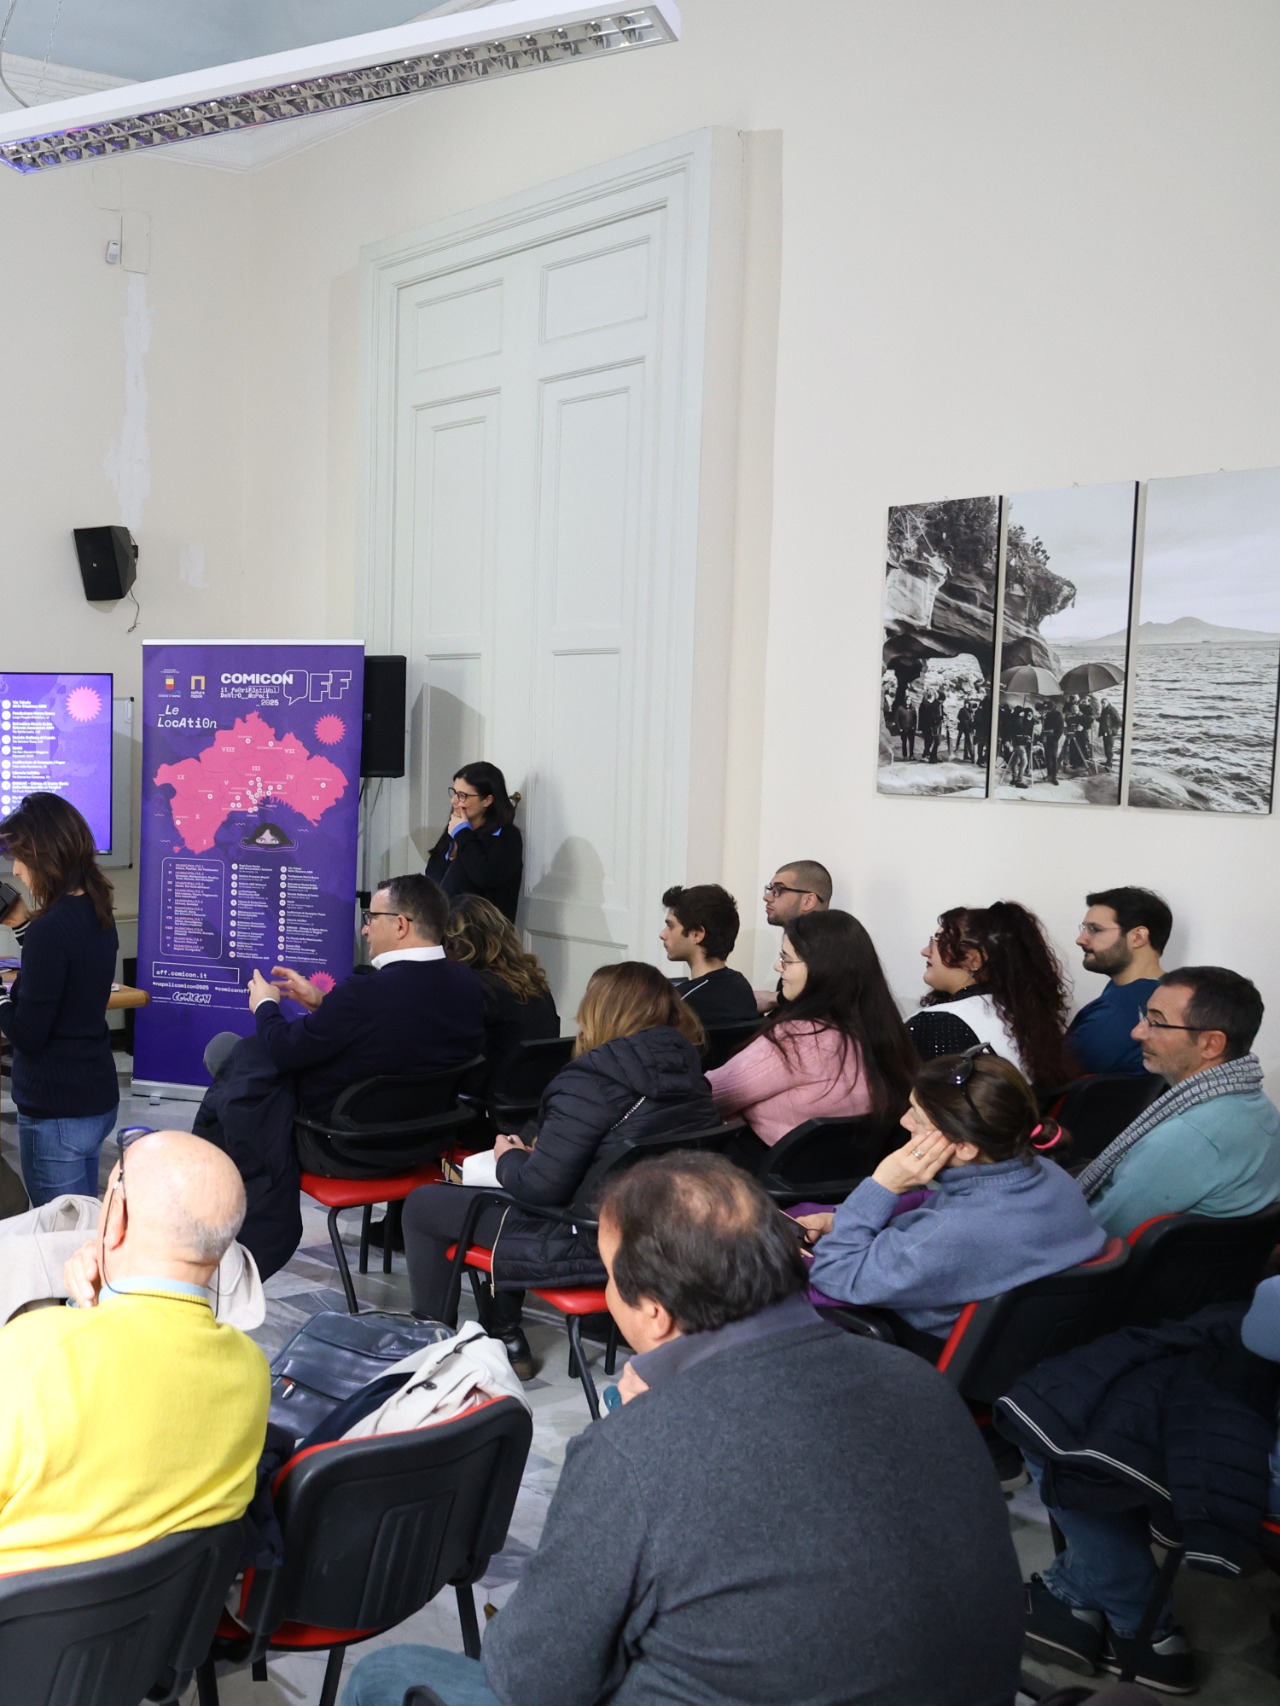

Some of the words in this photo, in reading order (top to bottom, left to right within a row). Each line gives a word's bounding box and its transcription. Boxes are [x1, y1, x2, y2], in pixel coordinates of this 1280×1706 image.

[220, 673, 294, 685] COMICON
[283, 669, 352, 706] OFF
[156, 969, 207, 979] off.comicon.it
